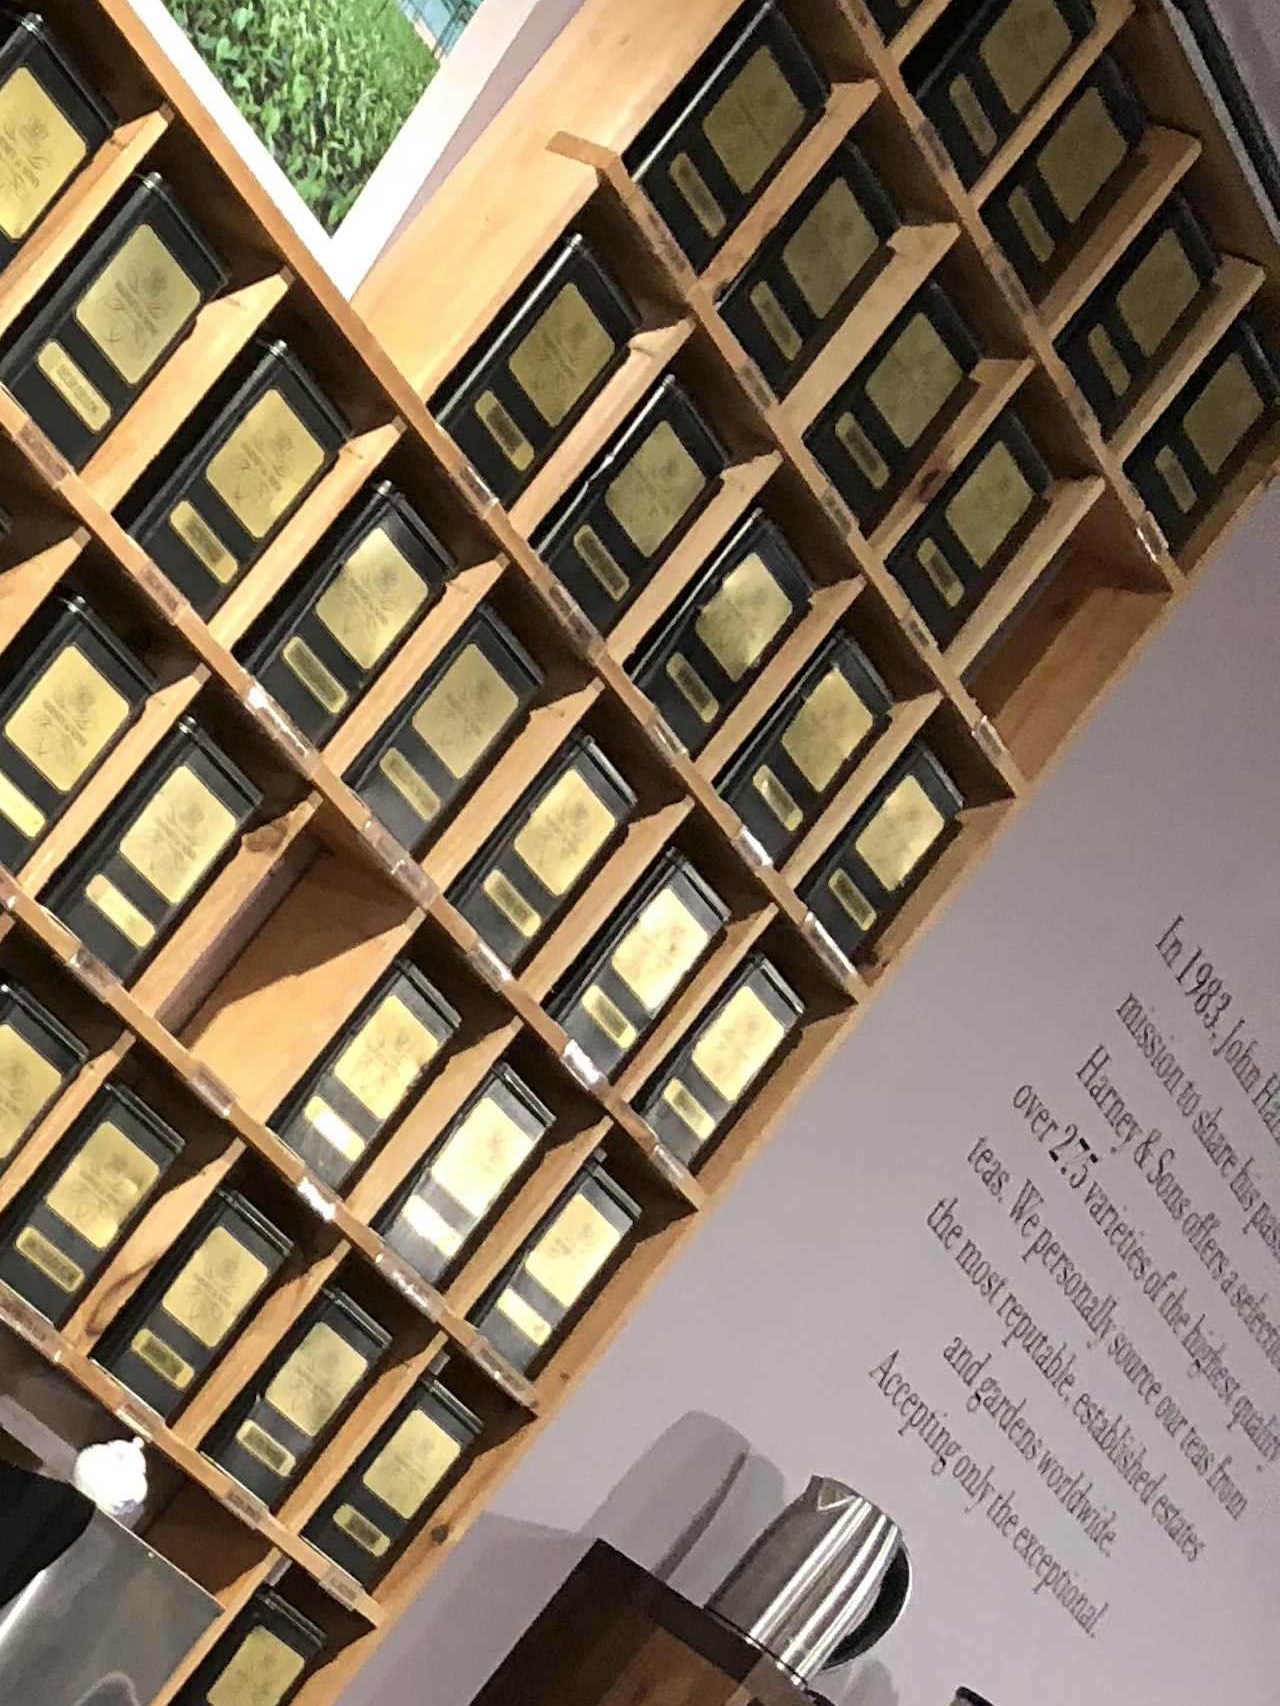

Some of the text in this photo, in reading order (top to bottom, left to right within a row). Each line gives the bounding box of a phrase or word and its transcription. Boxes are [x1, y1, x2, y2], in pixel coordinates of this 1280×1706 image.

[1154, 914, 1188, 969] In
[1210, 1016, 1266, 1094] John
[1008, 1081, 1056, 1146] over
[1045, 1121, 1102, 1191] 275
[1074, 1043, 1143, 1153] Harney
[1130, 1127, 1155, 1170] &
[1144, 1146, 1192, 1222] Sons
[1182, 1211, 1226, 1281] offers
[1218, 1268, 1239, 1296] a
[1115, 991, 1187, 1096] mission
[1173, 1079, 1201, 1120] to
[1188, 1107, 1239, 1180] share
[1227, 1155, 1262, 1213] his
[1079, 1179, 1153, 1282] varieties
[1140, 1268, 1179, 1304] of
[1156, 1288, 1191, 1337] the
[925, 1197, 965, 1251] the
[951, 1237, 1009, 1305] most
[1071, 1390, 1166, 1505] established
[1148, 1492, 1207, 1565] estates
[964, 1135, 1251, 1521] teas. We personally source our teas from
[1180, 1313, 1241, 1406] highest
[868, 1349, 1109, 1639] Accepting only the exceptional.
[941, 1334, 1117, 1559] and gardens worldwide.
